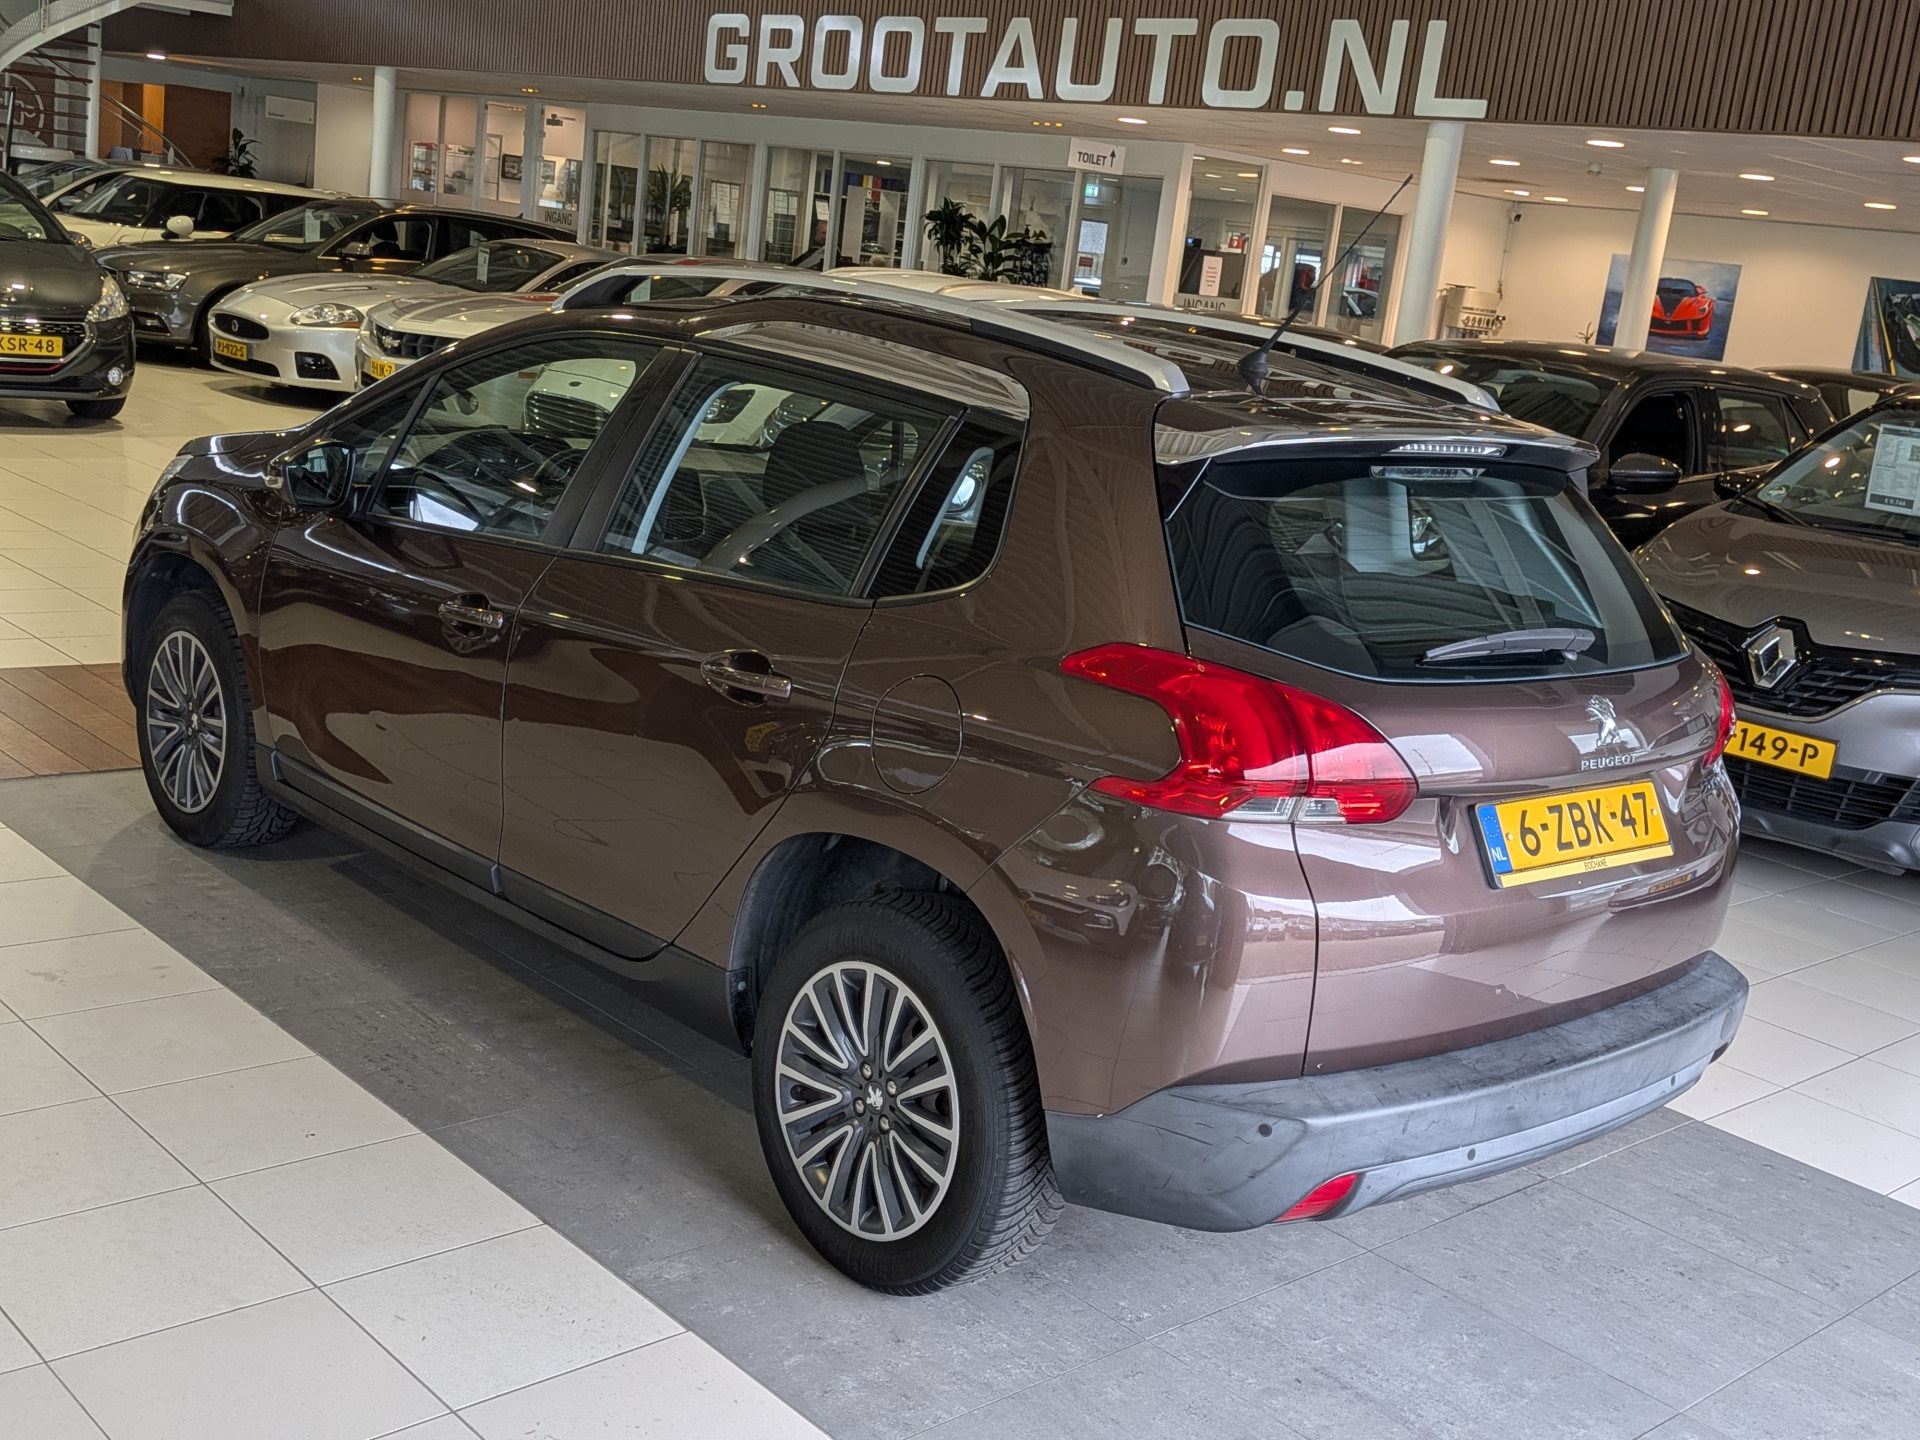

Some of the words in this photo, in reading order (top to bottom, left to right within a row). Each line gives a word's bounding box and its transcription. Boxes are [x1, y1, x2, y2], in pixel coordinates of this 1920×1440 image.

[704, 12, 1489, 119] GROOTAUTO.NL
[1077, 150, 1107, 167] TOILET
[544, 209, 573, 226] INGANG
[1581, 753, 1638, 771] PEUGEOT
[1519, 791, 1650, 857] 6-ZBK-47
[1490, 846, 1508, 862] NL
[1583, 858, 1609, 871] BOCHANE
